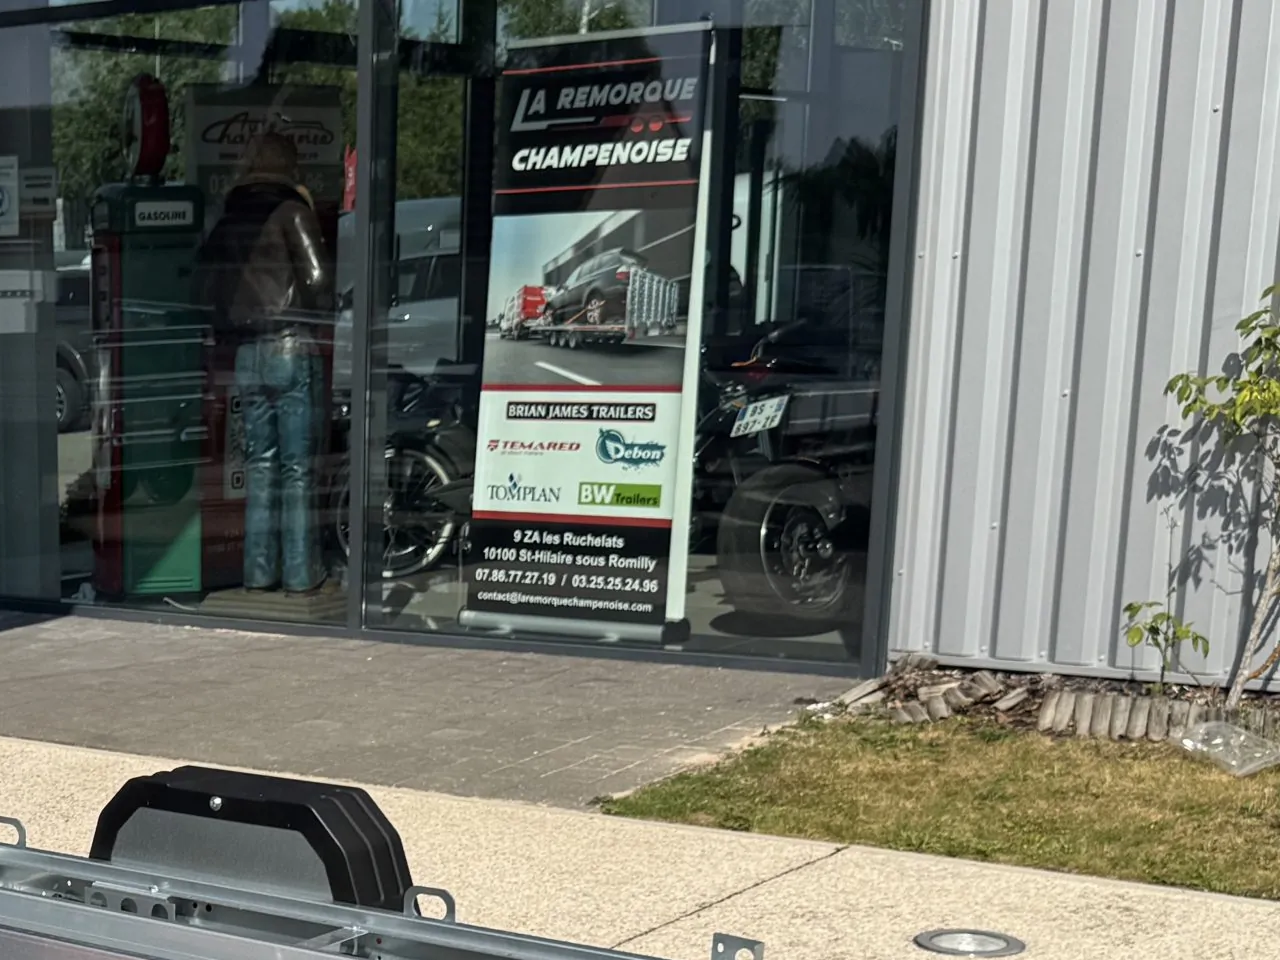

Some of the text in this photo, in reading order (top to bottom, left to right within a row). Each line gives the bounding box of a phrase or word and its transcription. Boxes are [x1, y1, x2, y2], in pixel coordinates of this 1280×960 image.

[510, 77, 698, 131] LA REMORQUE
[512, 138, 692, 171] CHAMPENOISE
[138, 209, 187, 221] GASOLINE
[508, 404, 654, 420] BRIAN JAMES TRAILERS
[501, 440, 581, 451] TEMARED
[612, 442, 662, 460] Debon
[487, 485, 561, 503] TOMPLAN
[580, 484, 658, 505] BW Trailers
[513, 530, 522, 542] 9
[523, 530, 540, 543] ZA
[542, 531, 561, 545] les
[483, 547, 657, 572] 10100 St-Hilaire sous Romilly
[475, 568, 556, 586] 07.86.77.27.19
[572, 575, 658, 592] 03.25.25.24.96
[477, 591, 652, 612] contact@laremorquechampenoise.com
